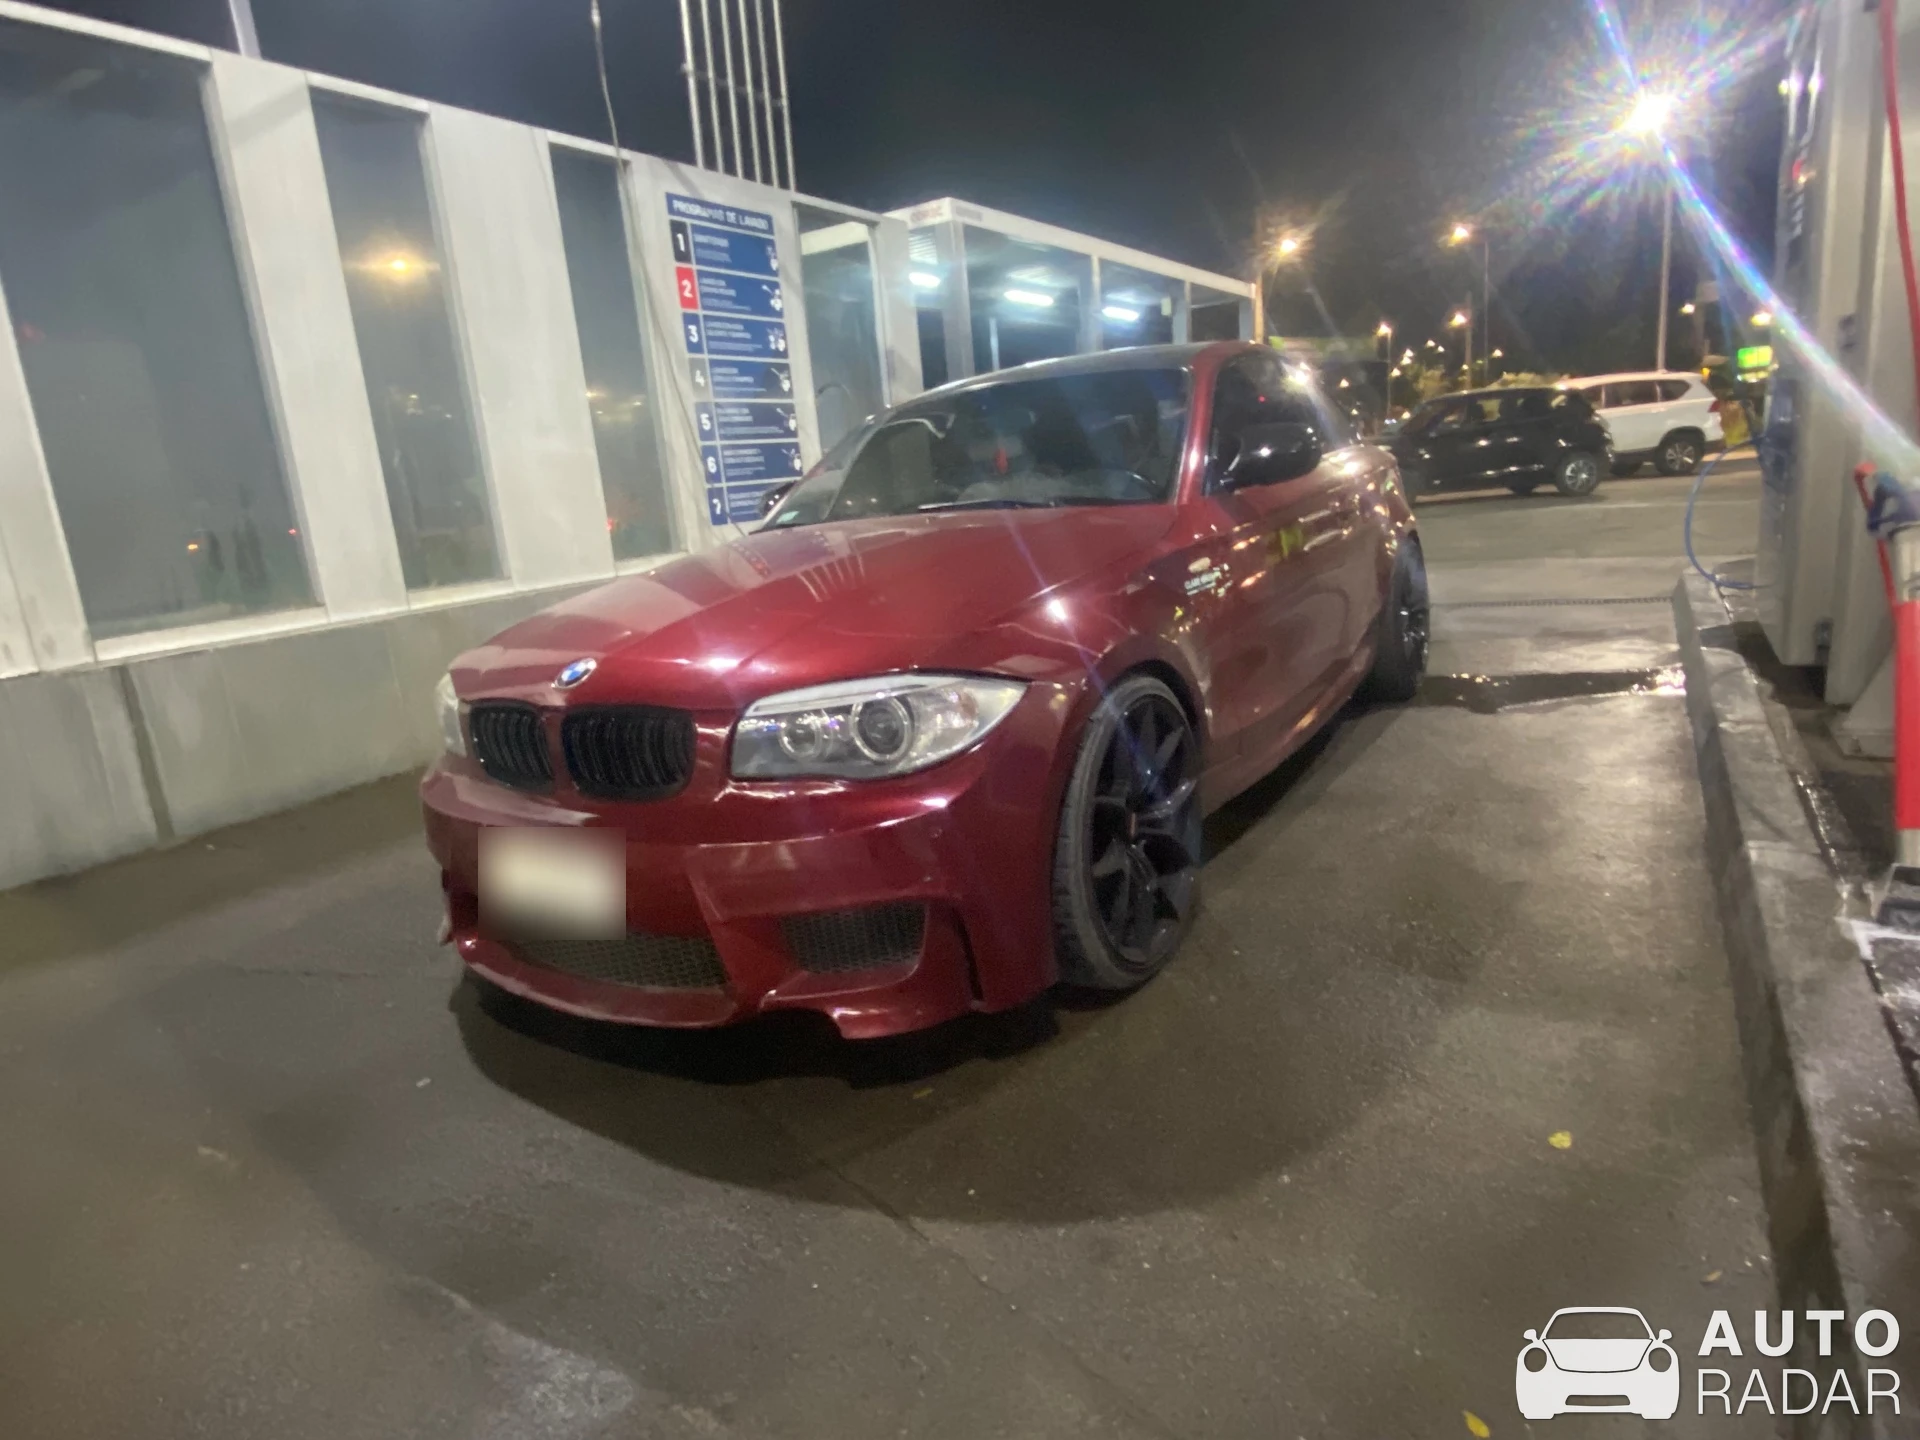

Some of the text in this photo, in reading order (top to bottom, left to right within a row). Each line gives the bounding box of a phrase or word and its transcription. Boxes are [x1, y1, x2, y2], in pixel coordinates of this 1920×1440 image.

[676, 232, 686, 252] 1
[681, 279, 694, 298] 2
[687, 324, 699, 343] 3
[695, 370, 705, 387] 4
[700, 413, 711, 431] 5
[706, 456, 717, 474] 6
[712, 498, 721, 515] 7
